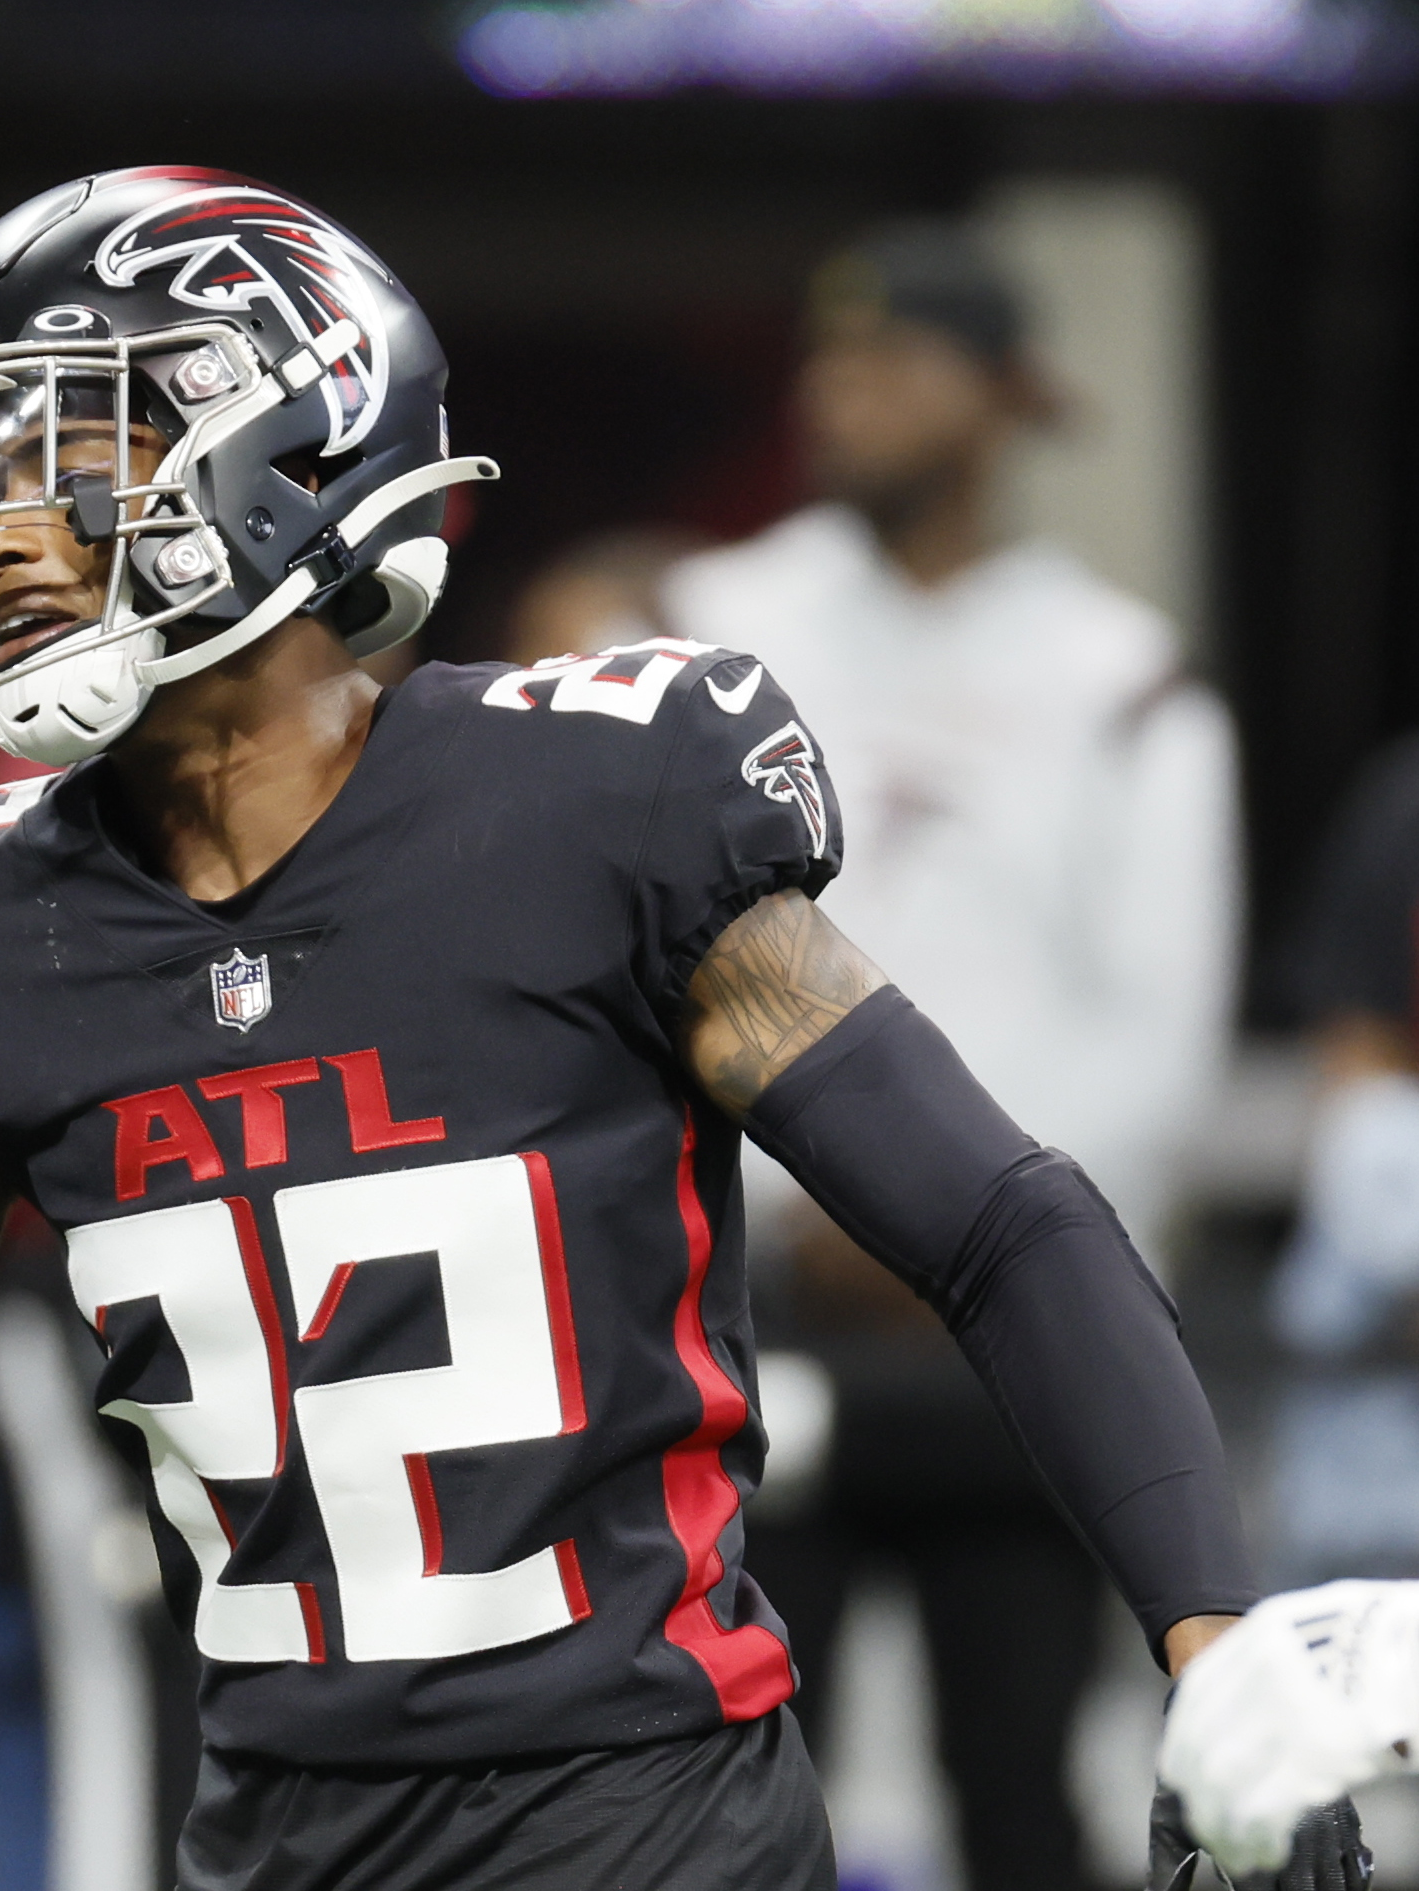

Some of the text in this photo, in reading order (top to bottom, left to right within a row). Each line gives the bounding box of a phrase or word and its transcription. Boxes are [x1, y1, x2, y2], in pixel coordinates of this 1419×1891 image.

[222, 987, 261, 1017] NFL
[100, 1047, 446, 1202] ATL
[66, 1150, 593, 1663] 22
